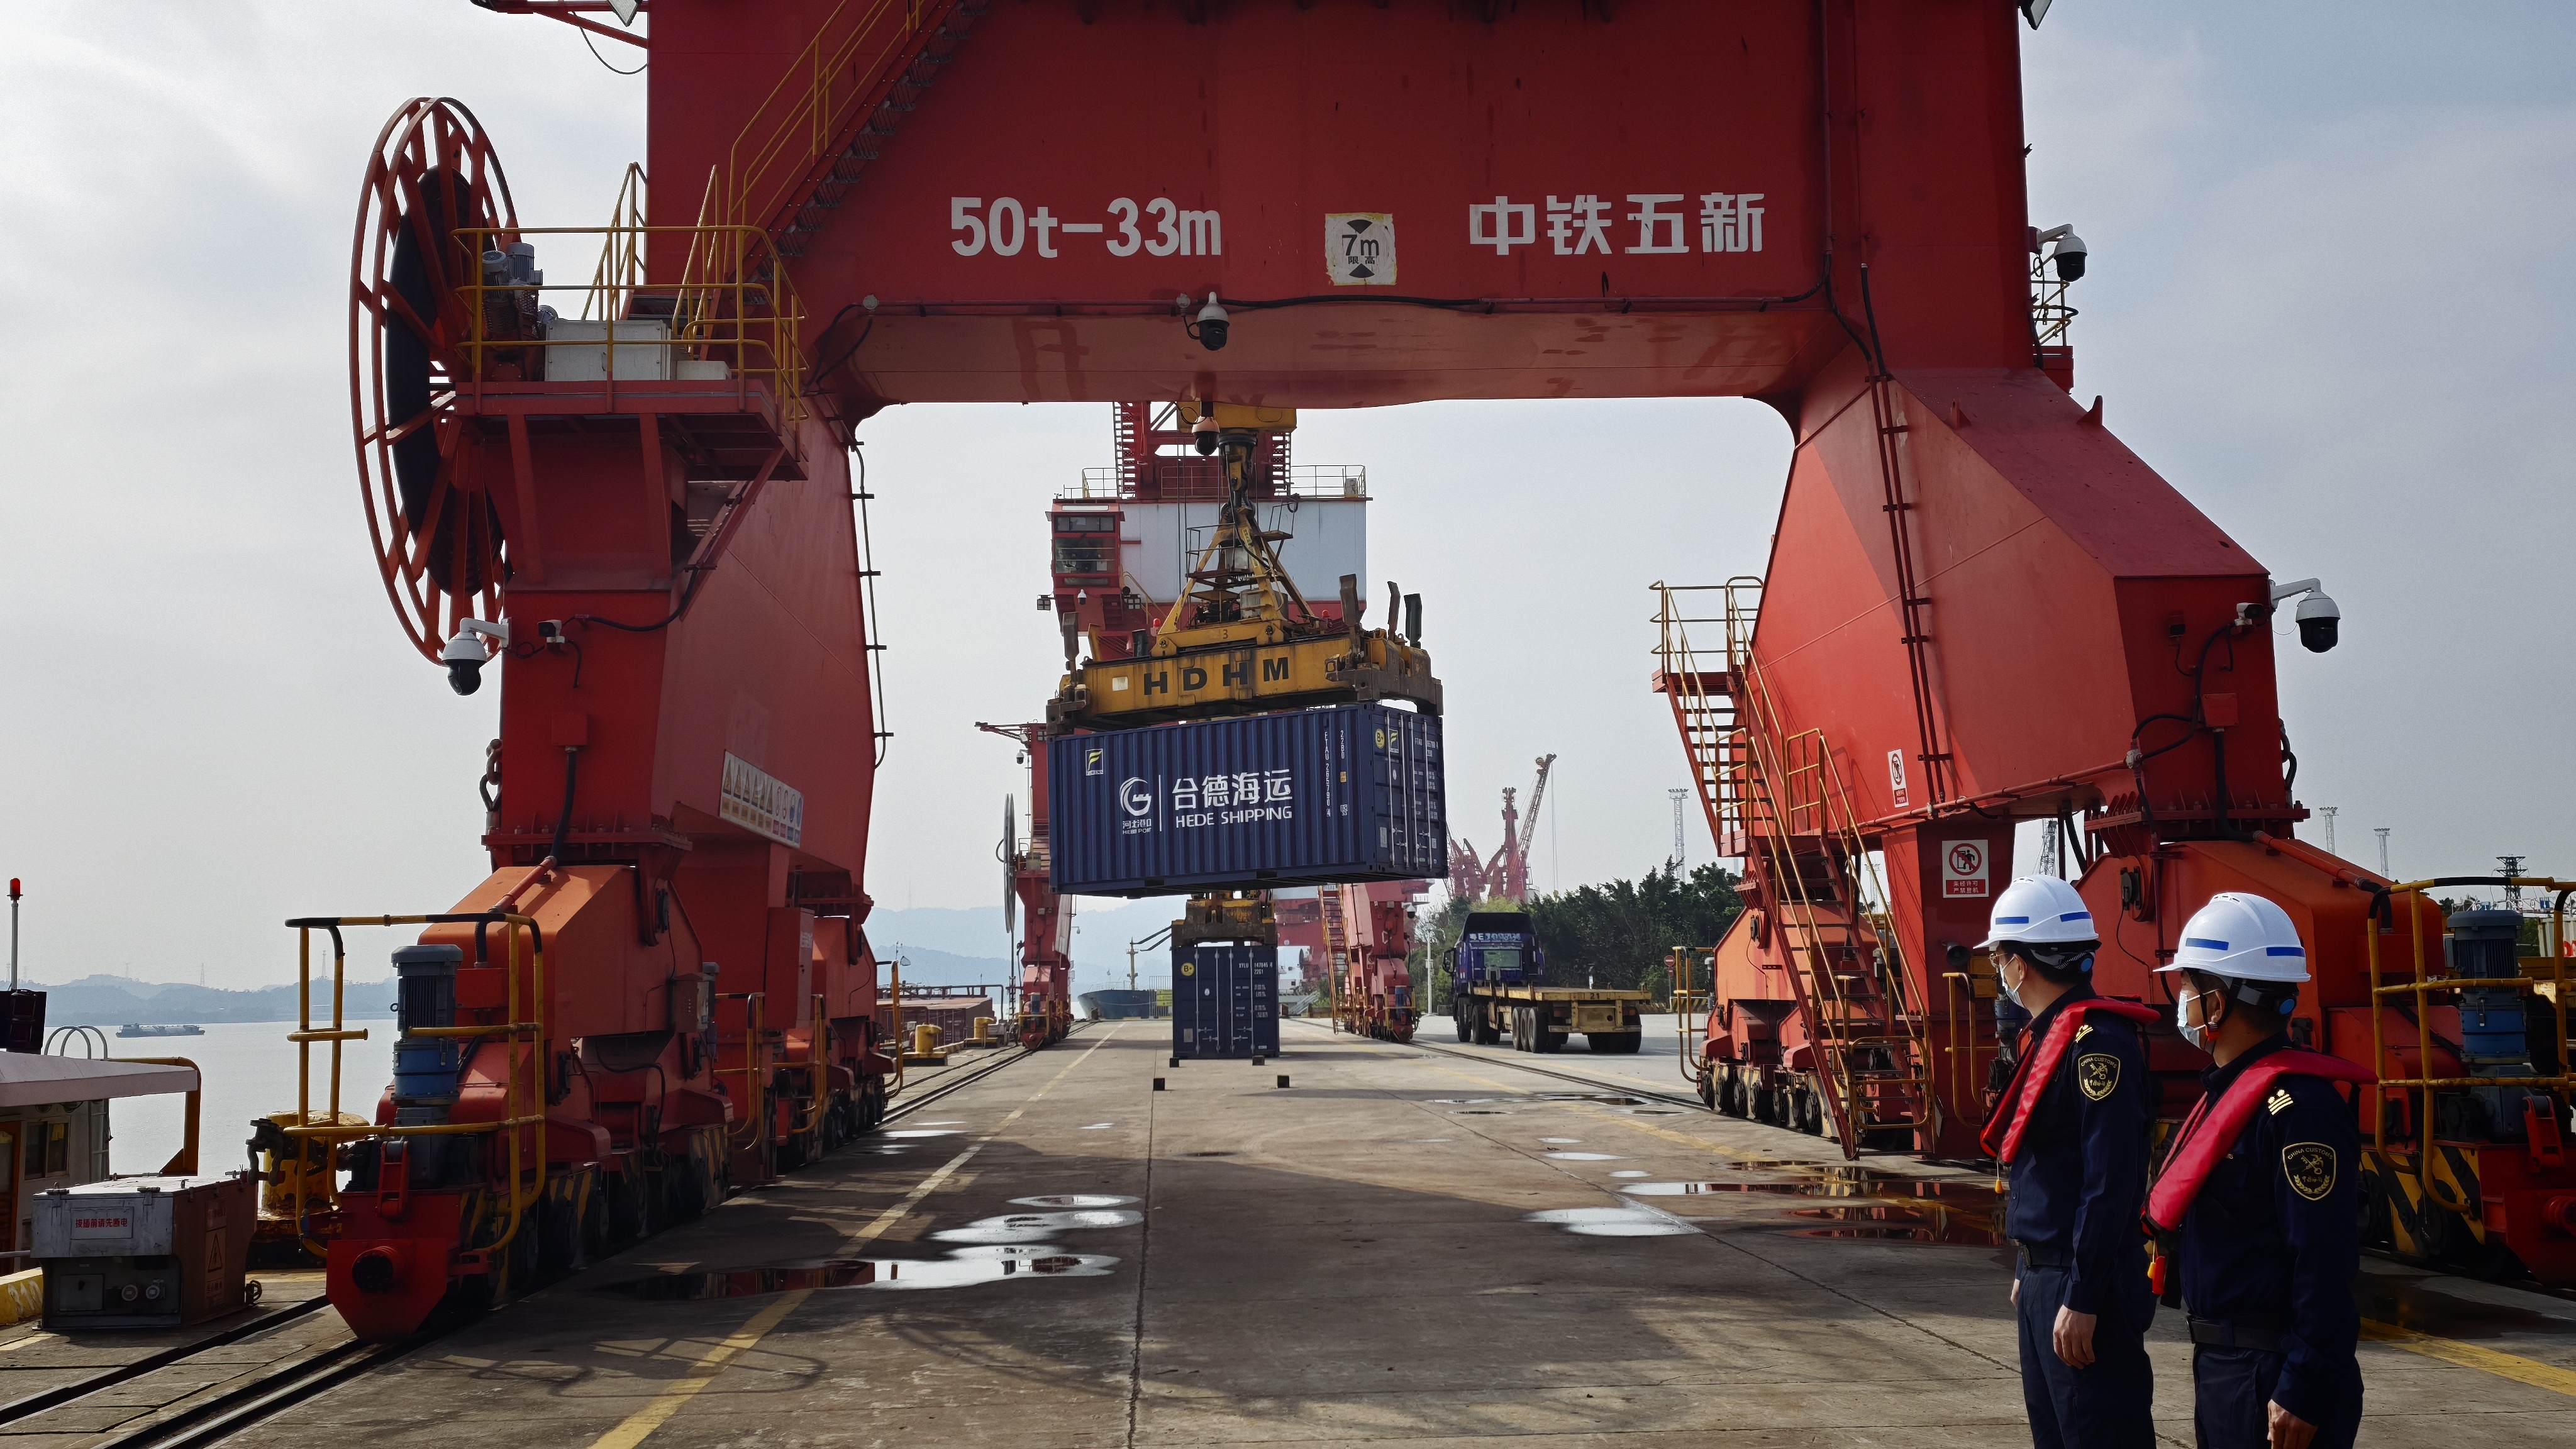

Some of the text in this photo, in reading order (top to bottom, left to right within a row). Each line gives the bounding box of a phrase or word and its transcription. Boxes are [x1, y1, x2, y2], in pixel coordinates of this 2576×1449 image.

[1469, 192, 1765, 255] 中铁五新
[1341, 234, 1379, 255] 7m
[1143, 657, 1289, 696] HDHM
[1172, 769, 1293, 811] 合德海运
[1175, 806, 1292, 828] HEDE SHIPPING
[2080, 1057, 2117, 1069] CHINA CUSTOMS
[2287, 1147, 2333, 1160] CHINA CUSTOMS
